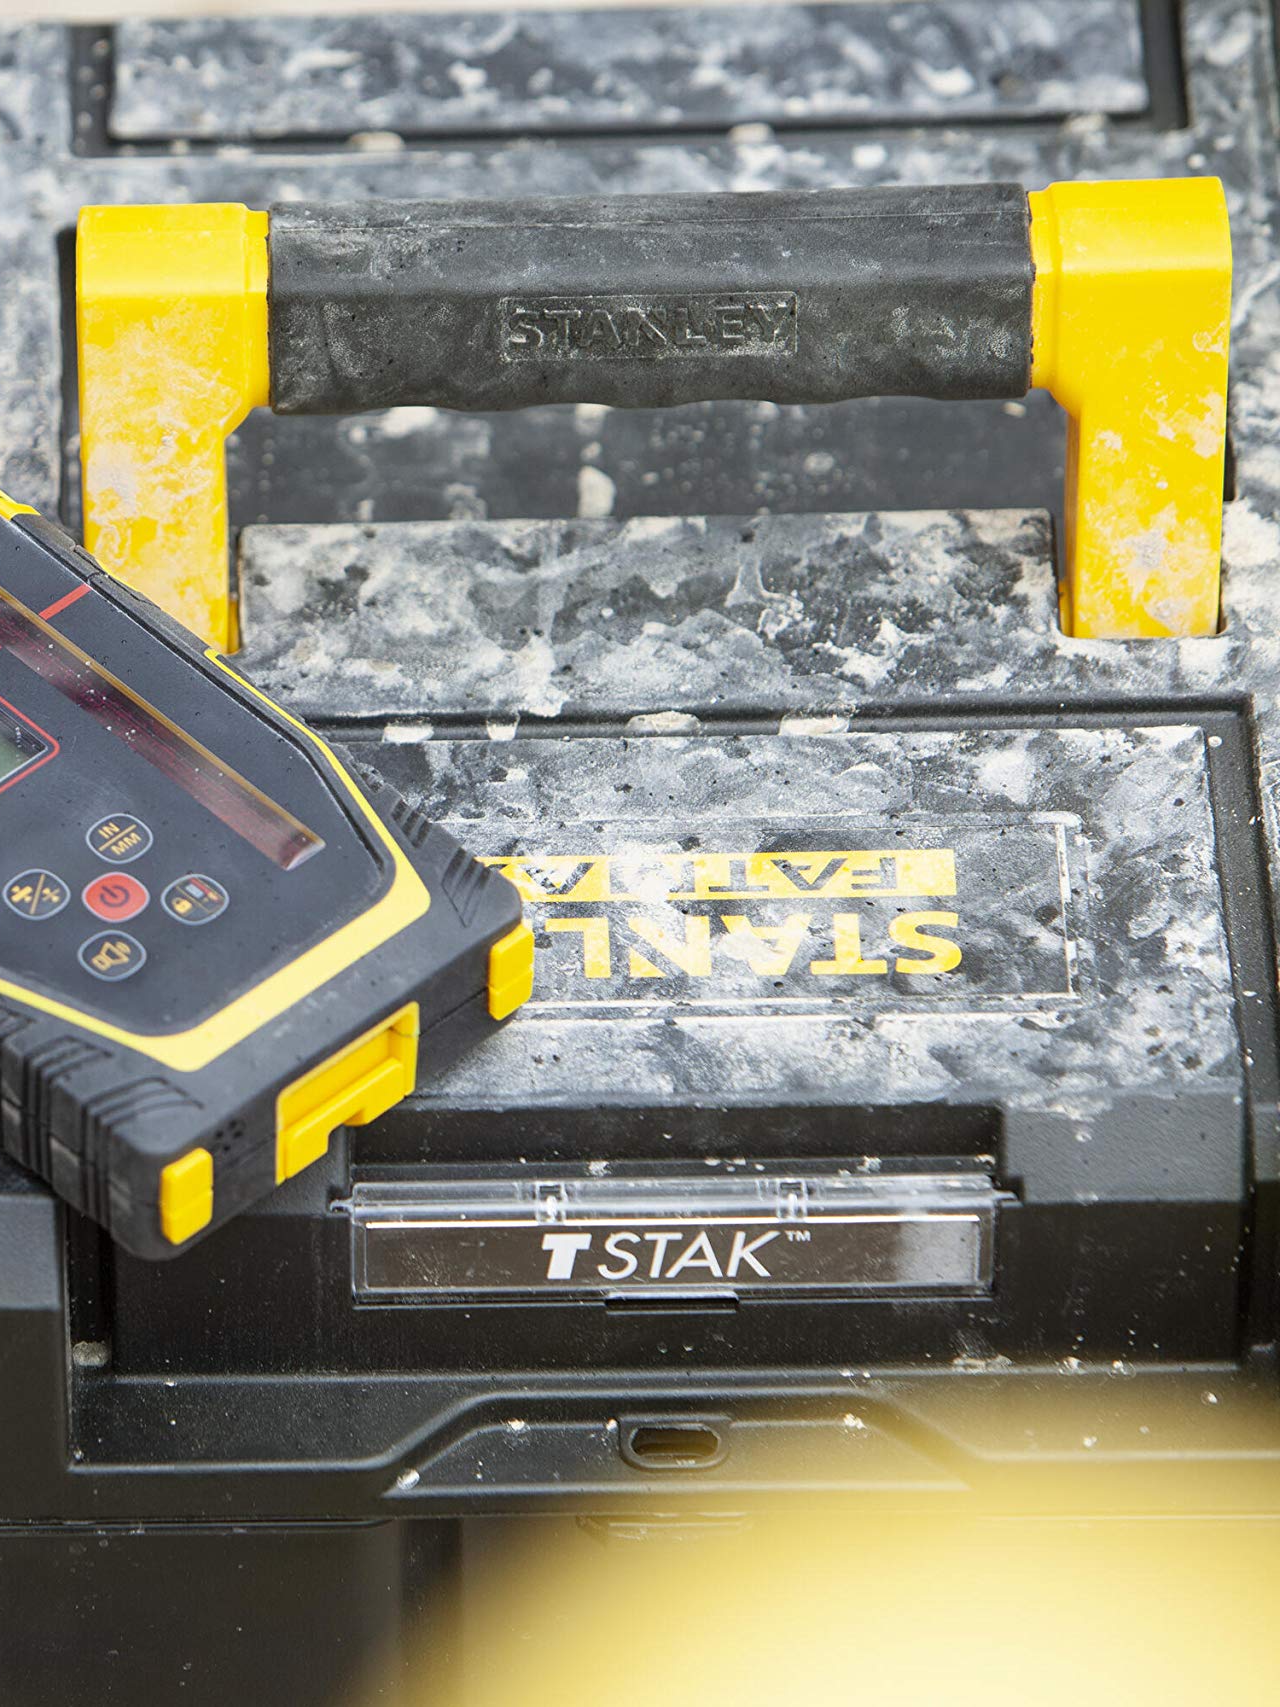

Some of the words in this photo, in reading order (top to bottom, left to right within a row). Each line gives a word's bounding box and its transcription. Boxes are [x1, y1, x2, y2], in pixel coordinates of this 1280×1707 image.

[508, 302, 789, 348] STANLEY
[98, 821, 120, 839] IN
[521, 910, 963, 977] STANL
